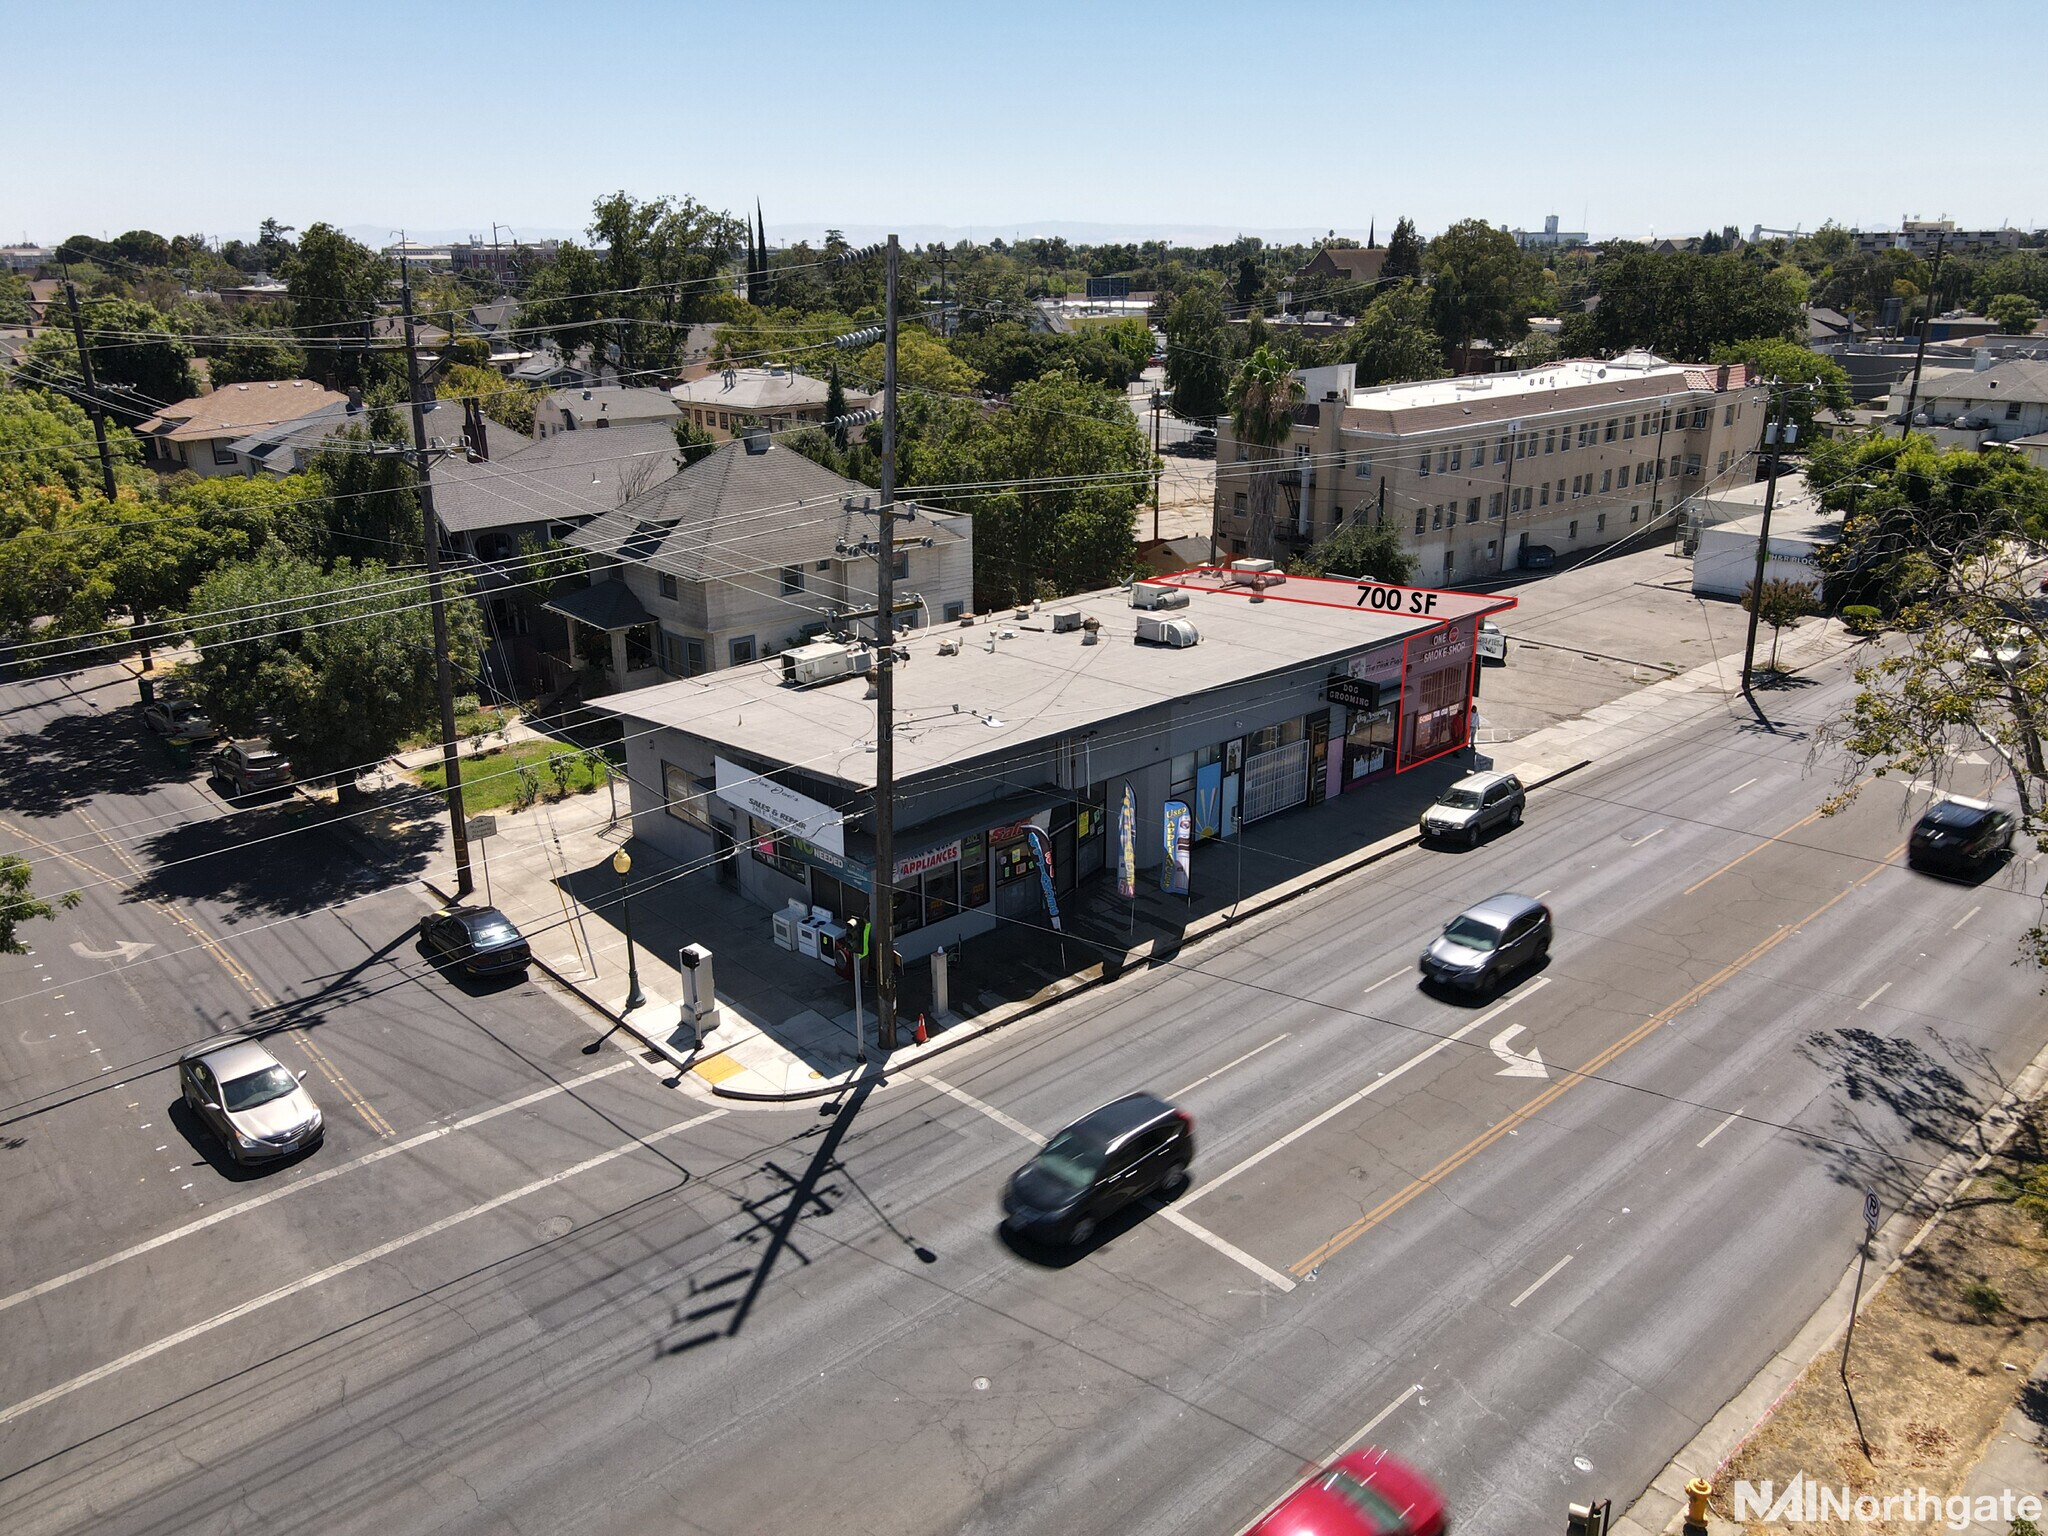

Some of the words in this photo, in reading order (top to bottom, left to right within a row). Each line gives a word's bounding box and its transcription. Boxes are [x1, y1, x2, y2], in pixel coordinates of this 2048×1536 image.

[1771, 553, 1790, 563] H&R
[1791, 556, 1820, 567] BLOCK
[1433, 633, 1447, 646] ONE
[1423, 647, 1447, 664] SMOKE
[1448, 642, 1466, 655] SHOP
[1343, 683, 1359, 694] DOG
[1329, 691, 1370, 707] GROOMING
[748, 798, 771, 812] SALES
[780, 813, 807, 830] REPAIR
[814, 848, 844, 868] NEEDED
[902, 846, 958, 876] APPLIANCES
